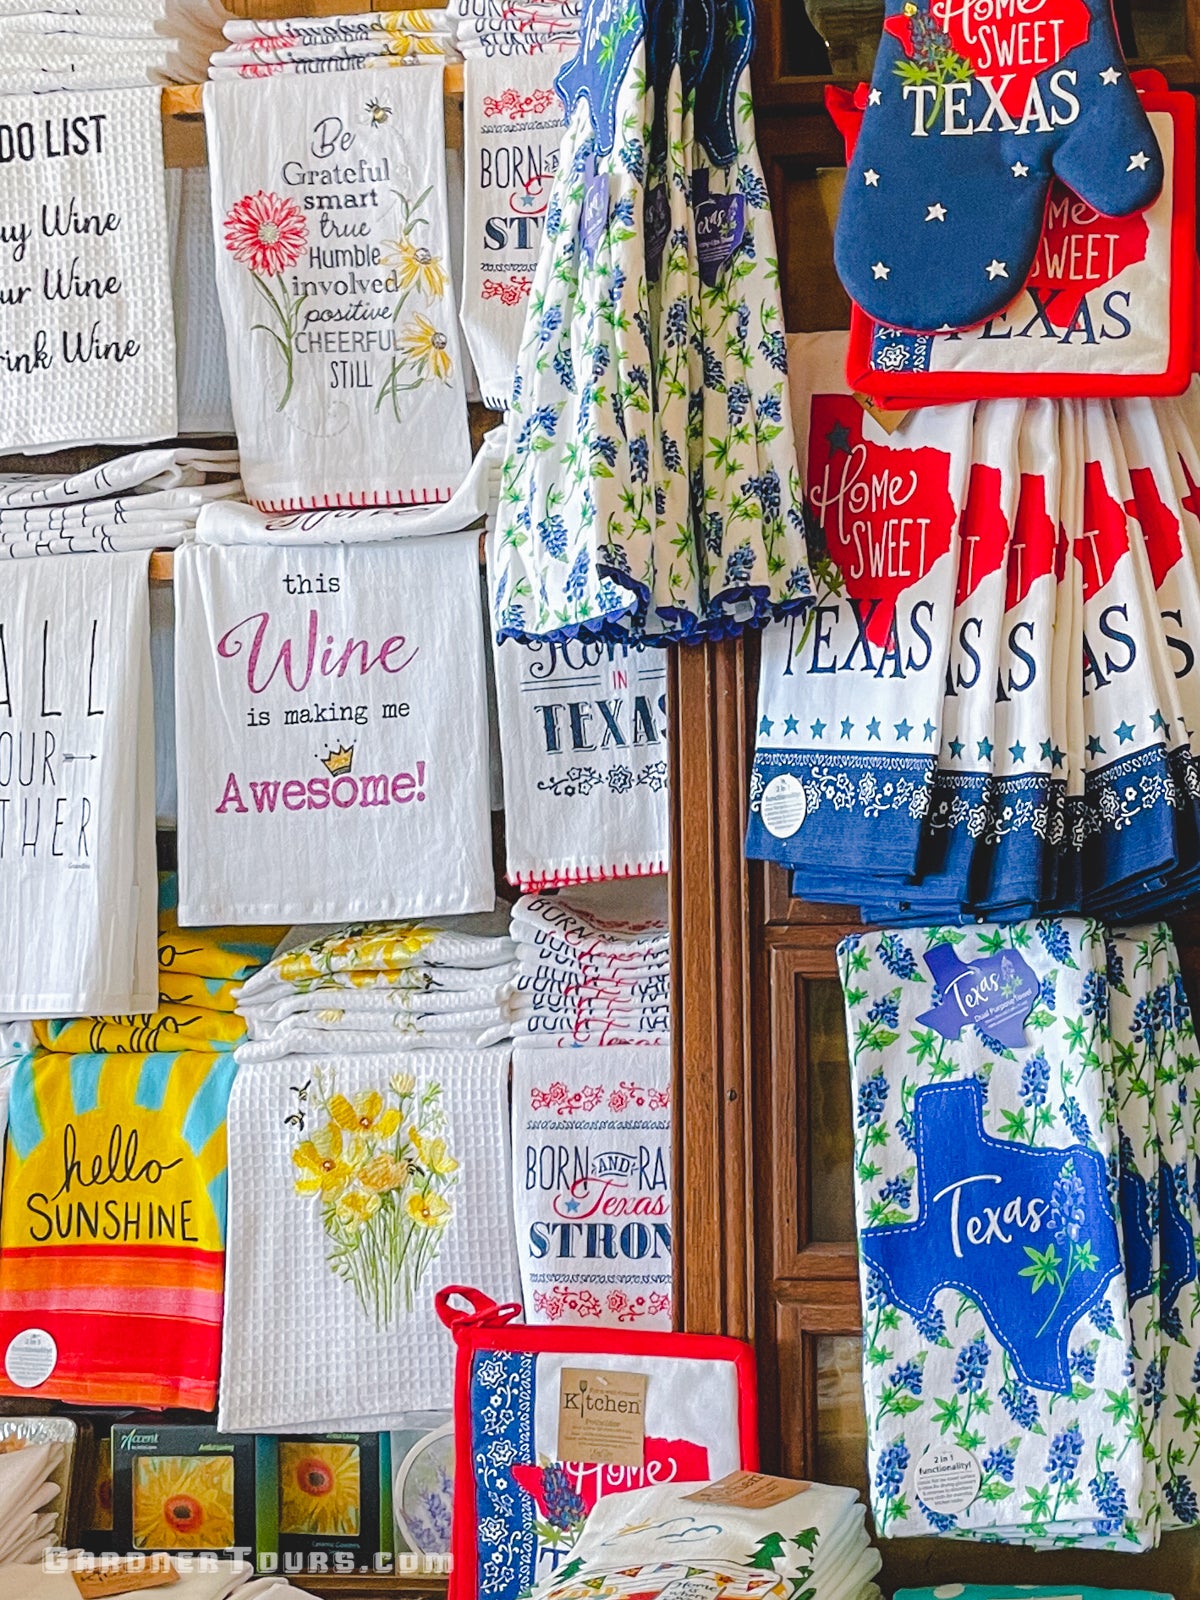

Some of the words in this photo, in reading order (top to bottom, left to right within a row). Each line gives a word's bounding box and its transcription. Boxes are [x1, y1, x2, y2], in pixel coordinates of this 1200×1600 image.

[977, 19, 1064, 69] SWEET
[902, 69, 1081, 137] TEXAS
[46, 115, 106, 158] LIST
[311, 117, 355, 158] Be
[281, 158, 390, 186] Grateful
[480, 145, 542, 188] BORN
[42, 197, 121, 237] Wine
[303, 189, 379, 210] smart
[319, 215, 371, 240] true
[43, 257, 122, 300] Wine
[308, 245, 381, 270] Humble
[292, 272, 400, 296] involved
[303, 301, 393, 332] positive
[63, 320, 140, 364] Wine
[294, 331, 404, 355] CHEERFUL
[330, 360, 374, 390] STILL
[850, 518, 931, 580] SWEET
[282, 573, 341, 594] this
[217, 609, 419, 694] Wine
[782, 597, 935, 679] TEXAS
[613, 670, 628, 690] IN
[247, 707, 271, 727] is
[284, 703, 369, 725] making
[382, 701, 410, 719] me
[215, 760, 427, 813] Awesome!
[944, 970, 1000, 1017] Texas
[51, 1123, 183, 1201] hello
[526, 1145, 589, 1190] BORN
[598, 1156, 630, 1173] AND
[26, 1193, 199, 1243] SUNSHINE
[553, 1177, 670, 1220] Texas
[933, 1175, 1049, 1258] Texas
[121, 1429, 159, 1450] Accent
[919, 1461, 971, 1475] functionality!
